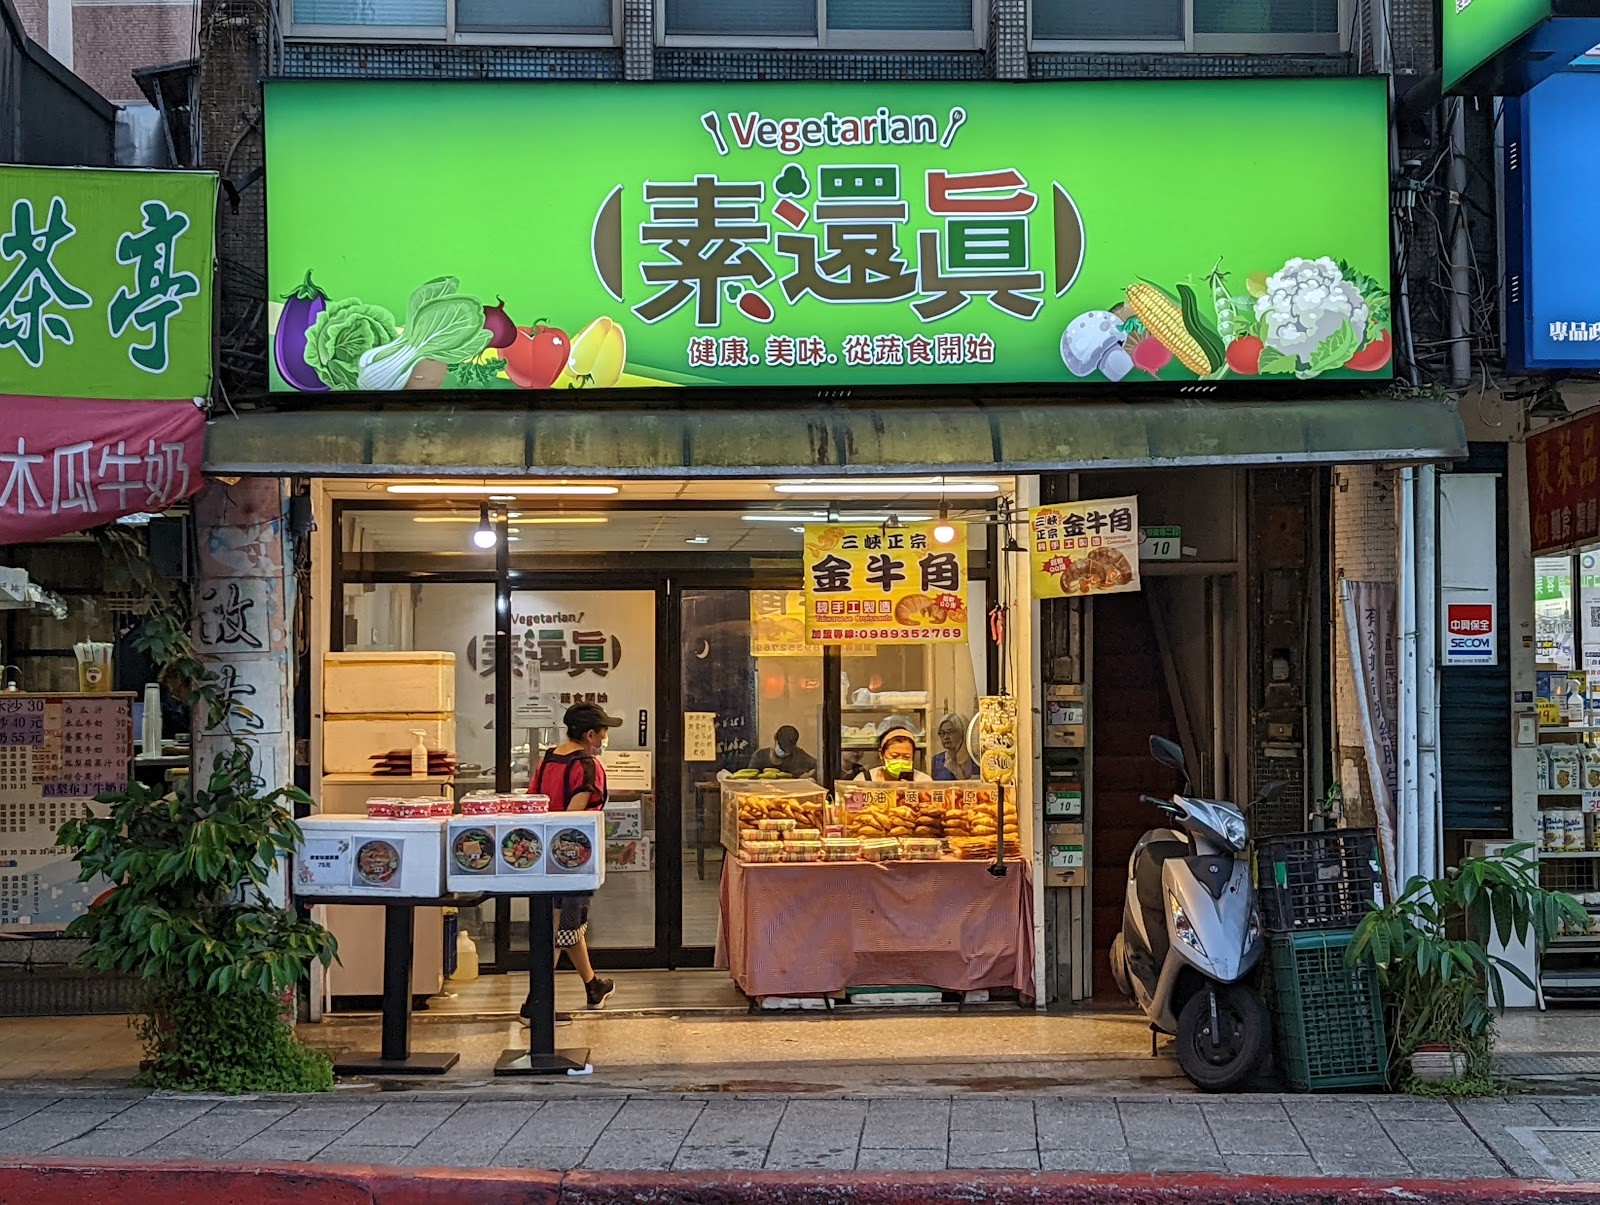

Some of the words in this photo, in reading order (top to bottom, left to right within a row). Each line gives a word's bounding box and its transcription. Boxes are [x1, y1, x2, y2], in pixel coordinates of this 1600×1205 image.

[729, 107, 937, 153] Vegetarian
[0, 196, 200, 374] 茶亭
[0, 436, 190, 515] 木瓜牛奶
[1063, 507, 1132, 537] 金牛角
[842, 533, 928, 550] 三峽正宗
[1152, 541, 1170, 555] 10
[811, 553, 960, 593] 金牛角
[511, 612, 576, 626] Vegetarian
[1451, 620, 1490, 630] 中興保全
[1451, 638, 1490, 648] SECOM
[28, 700, 44, 712] 30
[1062, 711, 1074, 721] 10
[11, 733, 25, 743] 55
[863, 790, 887, 803] 奶油
[1060, 801, 1071, 811] 10
[1062, 854, 1073, 864] 10
